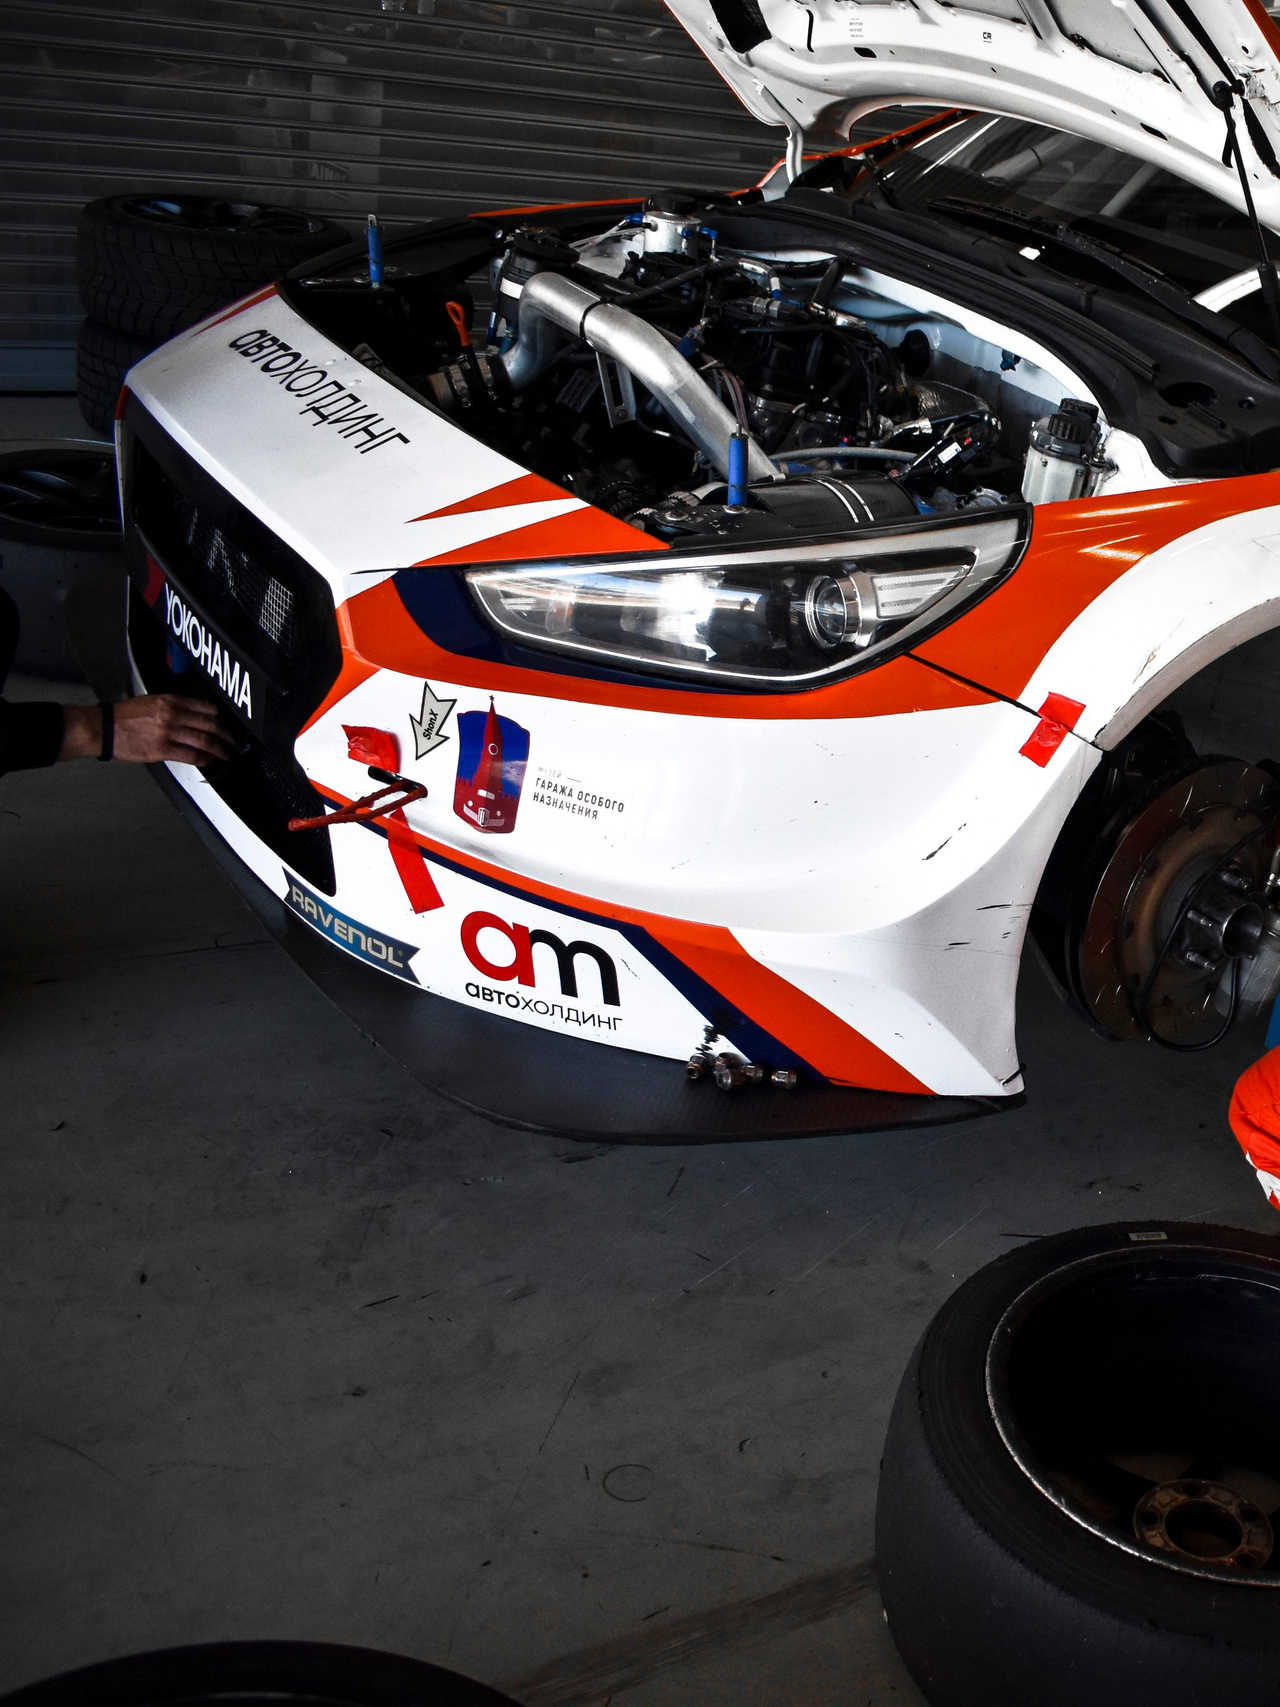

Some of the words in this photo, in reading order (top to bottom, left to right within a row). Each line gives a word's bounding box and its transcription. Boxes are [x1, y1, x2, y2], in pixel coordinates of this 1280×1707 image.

[165, 582, 252, 719] YOKOHAMA
[422, 708, 439, 741] ShonX
[538, 766, 562, 779] МУЗЕЙ
[532, 791, 599, 820] НАЗНАЧЕНИЯ
[535, 777, 574, 799] ГАРАЖА
[577, 790, 625, 813] ОСОБОГО
[291, 884, 404, 969] RAVENOL
